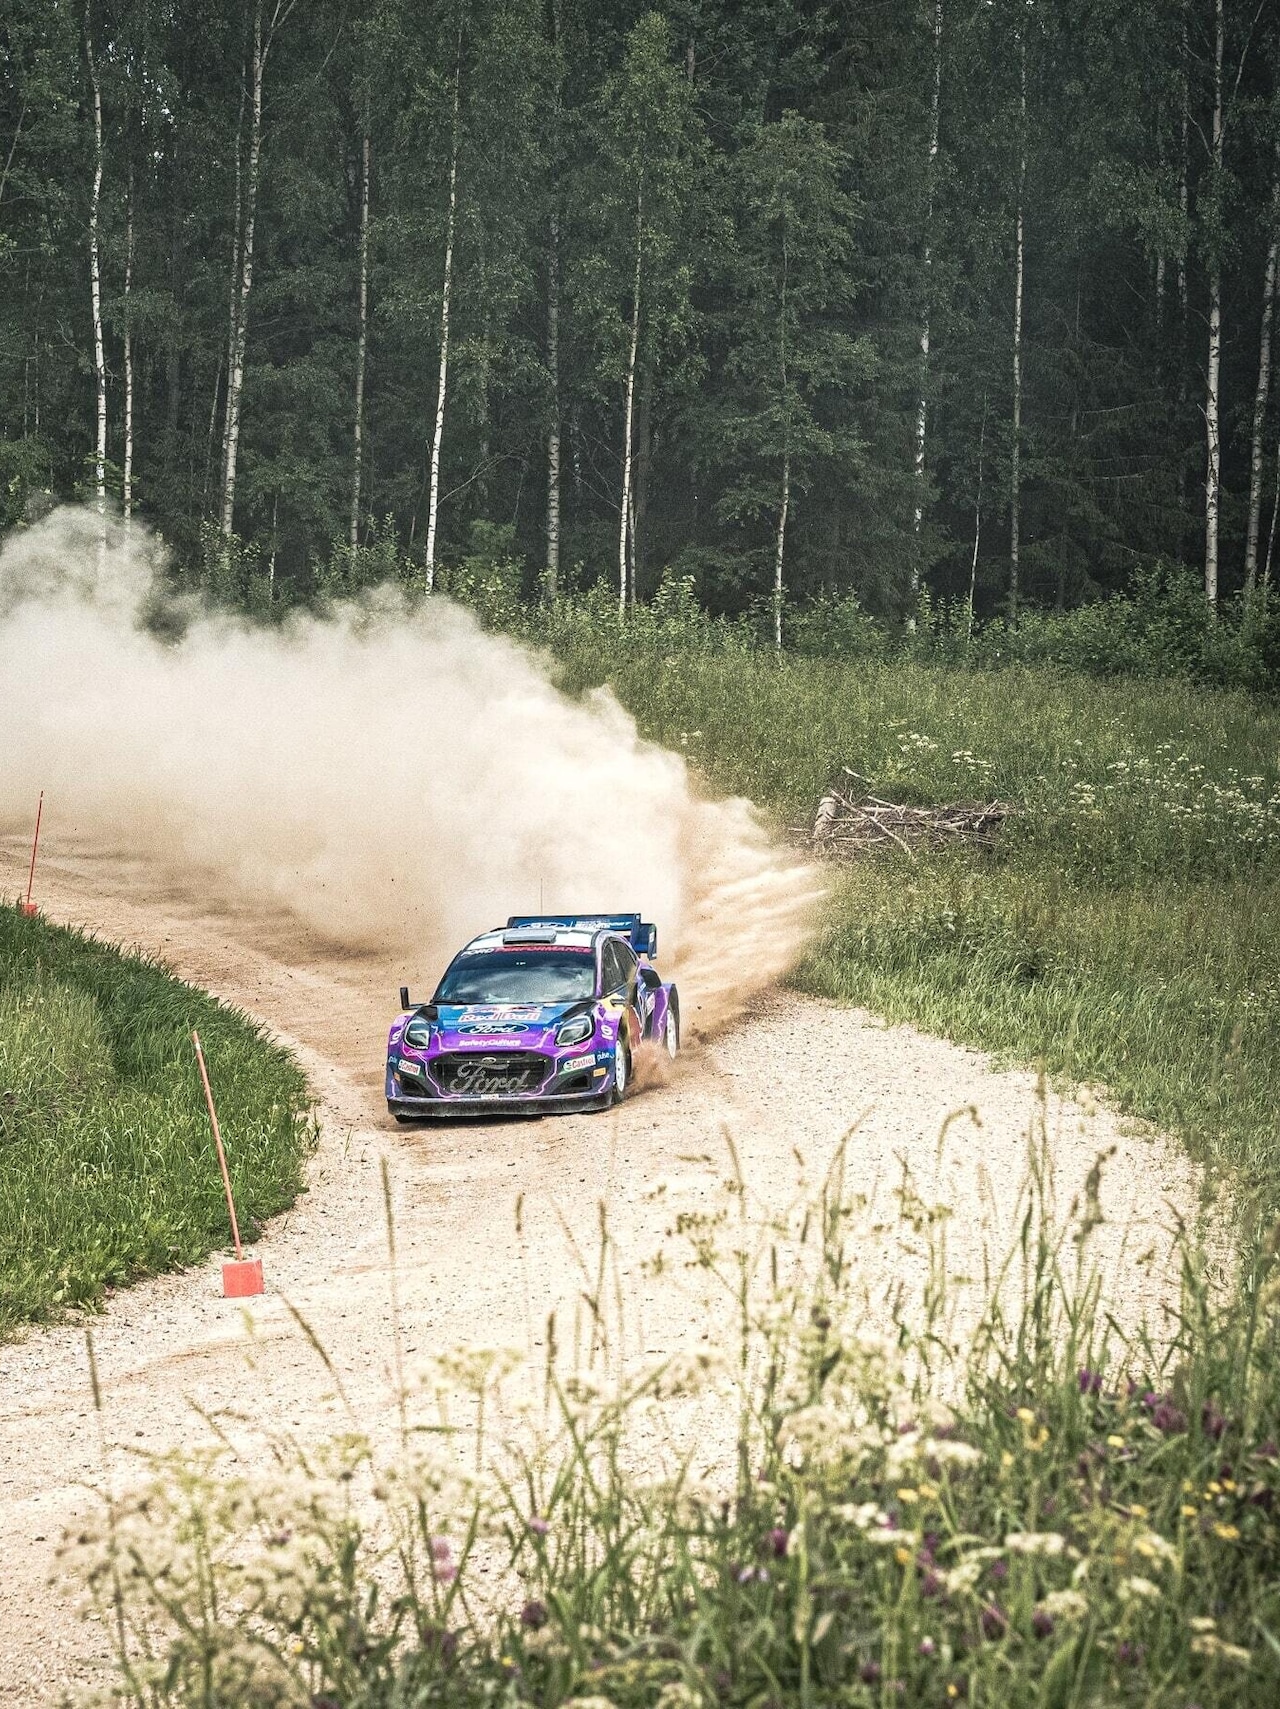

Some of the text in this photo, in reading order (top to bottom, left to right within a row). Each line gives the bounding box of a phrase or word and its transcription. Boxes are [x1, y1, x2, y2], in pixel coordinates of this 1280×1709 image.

[495, 945, 592, 954] PERFORMANCE
[459, 1012, 539, 1021] Red Bull
[572, 1056, 594, 1069] Castrol
[450, 1062, 531, 1094] Ford
